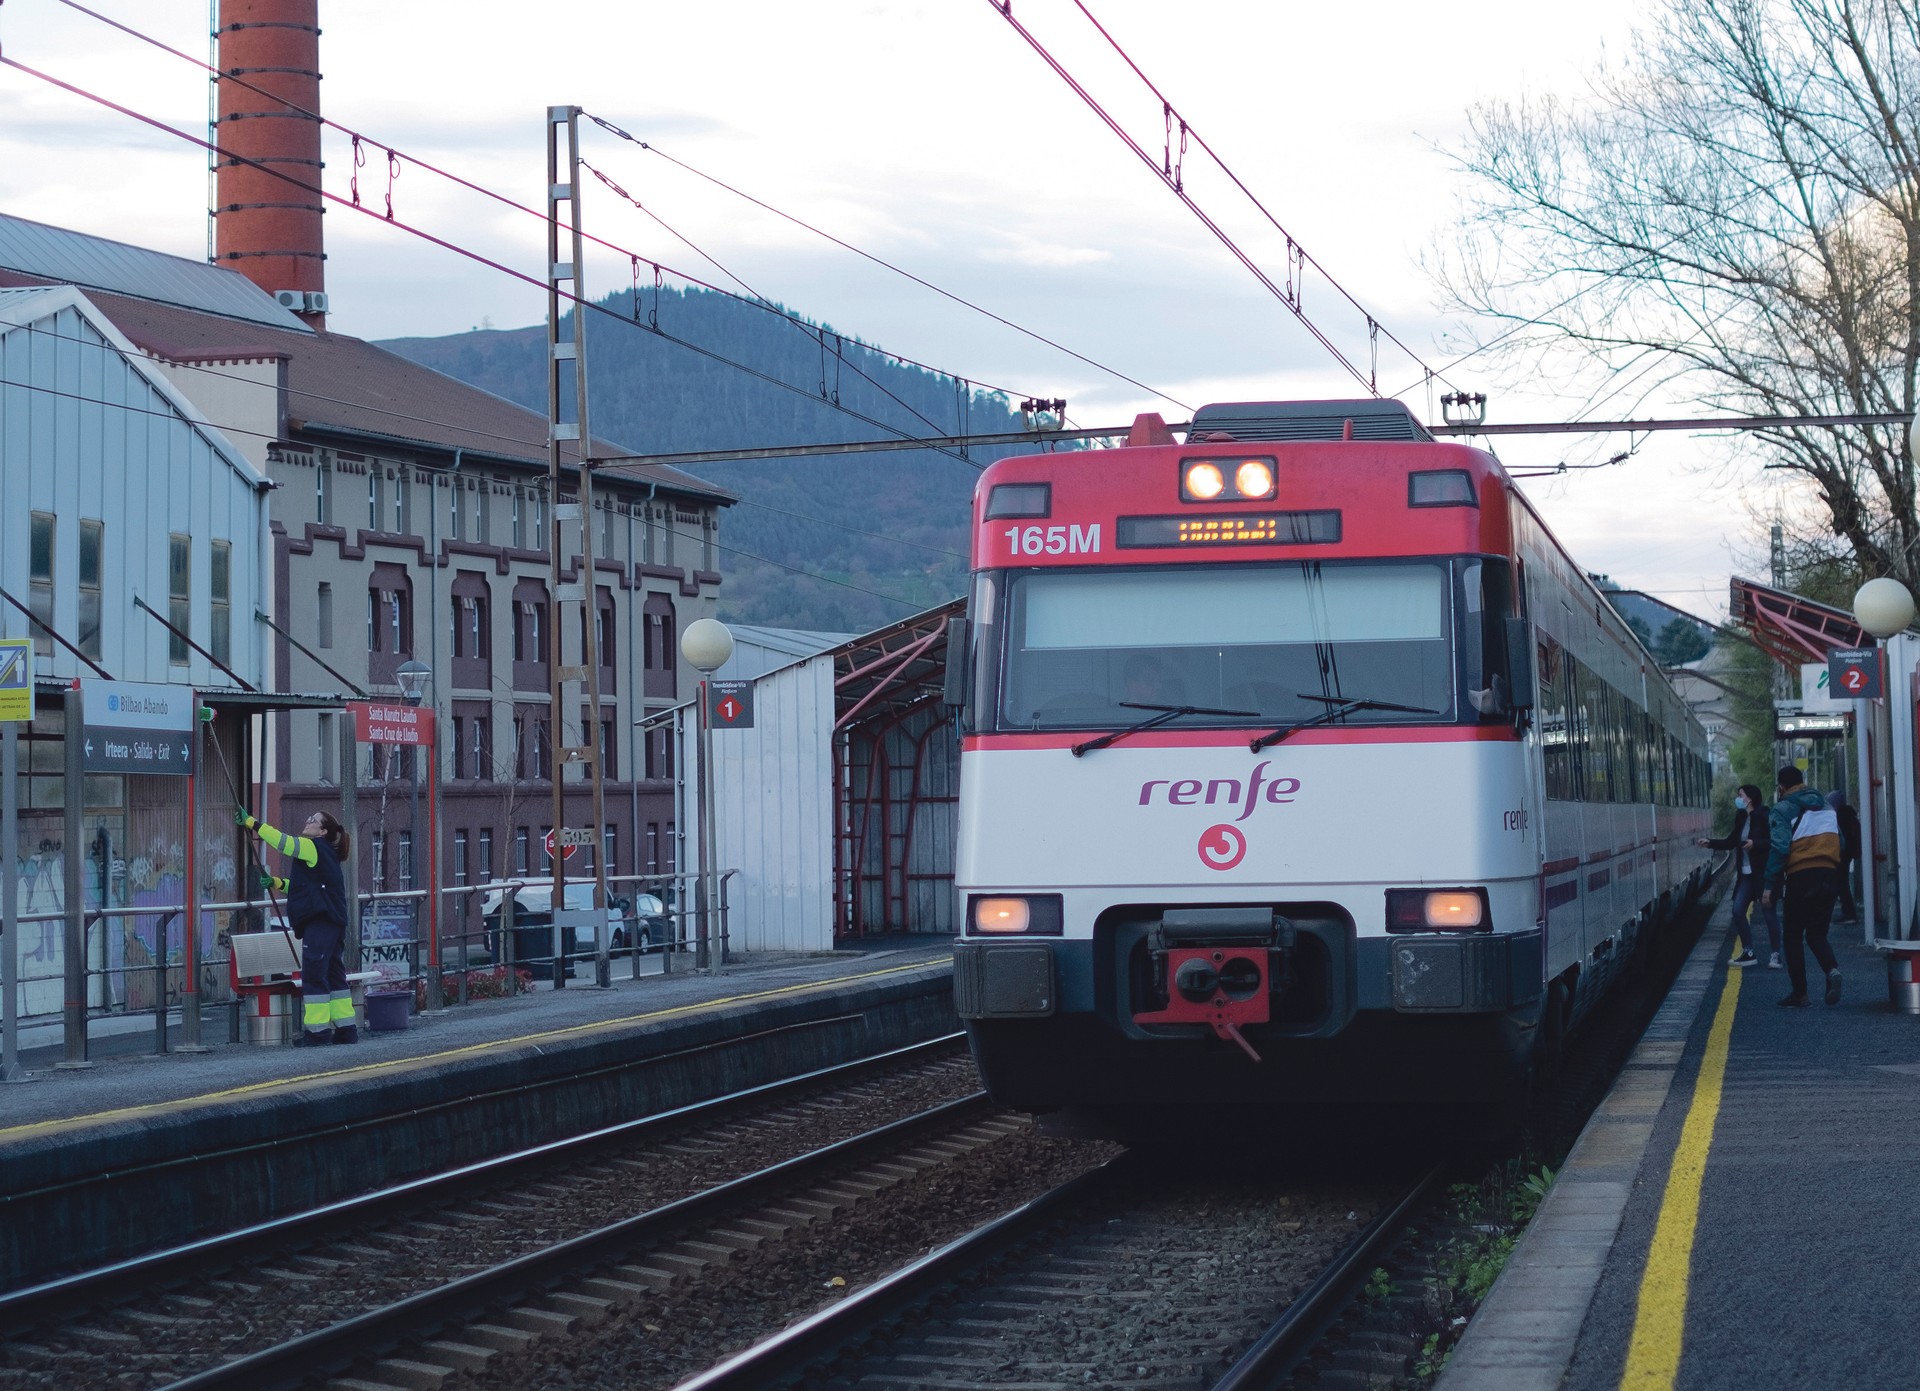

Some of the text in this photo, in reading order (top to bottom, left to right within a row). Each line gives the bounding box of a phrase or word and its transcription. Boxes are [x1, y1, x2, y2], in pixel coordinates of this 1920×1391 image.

[1005, 524, 1101, 555] 165M
[1849, 671, 1860, 689] 2
[121, 696, 168, 715] Bilbao Abando
[369, 706, 383, 721] Santa
[725, 701, 733, 718] 1
[369, 725, 418, 742] Santa Cruz de Llodio
[105, 741, 170, 760] Irteera Salida Exit
[1138, 760, 1301, 821] renfe
[1504, 797, 1528, 843] renfe
[565, 831, 591, 844] 595
